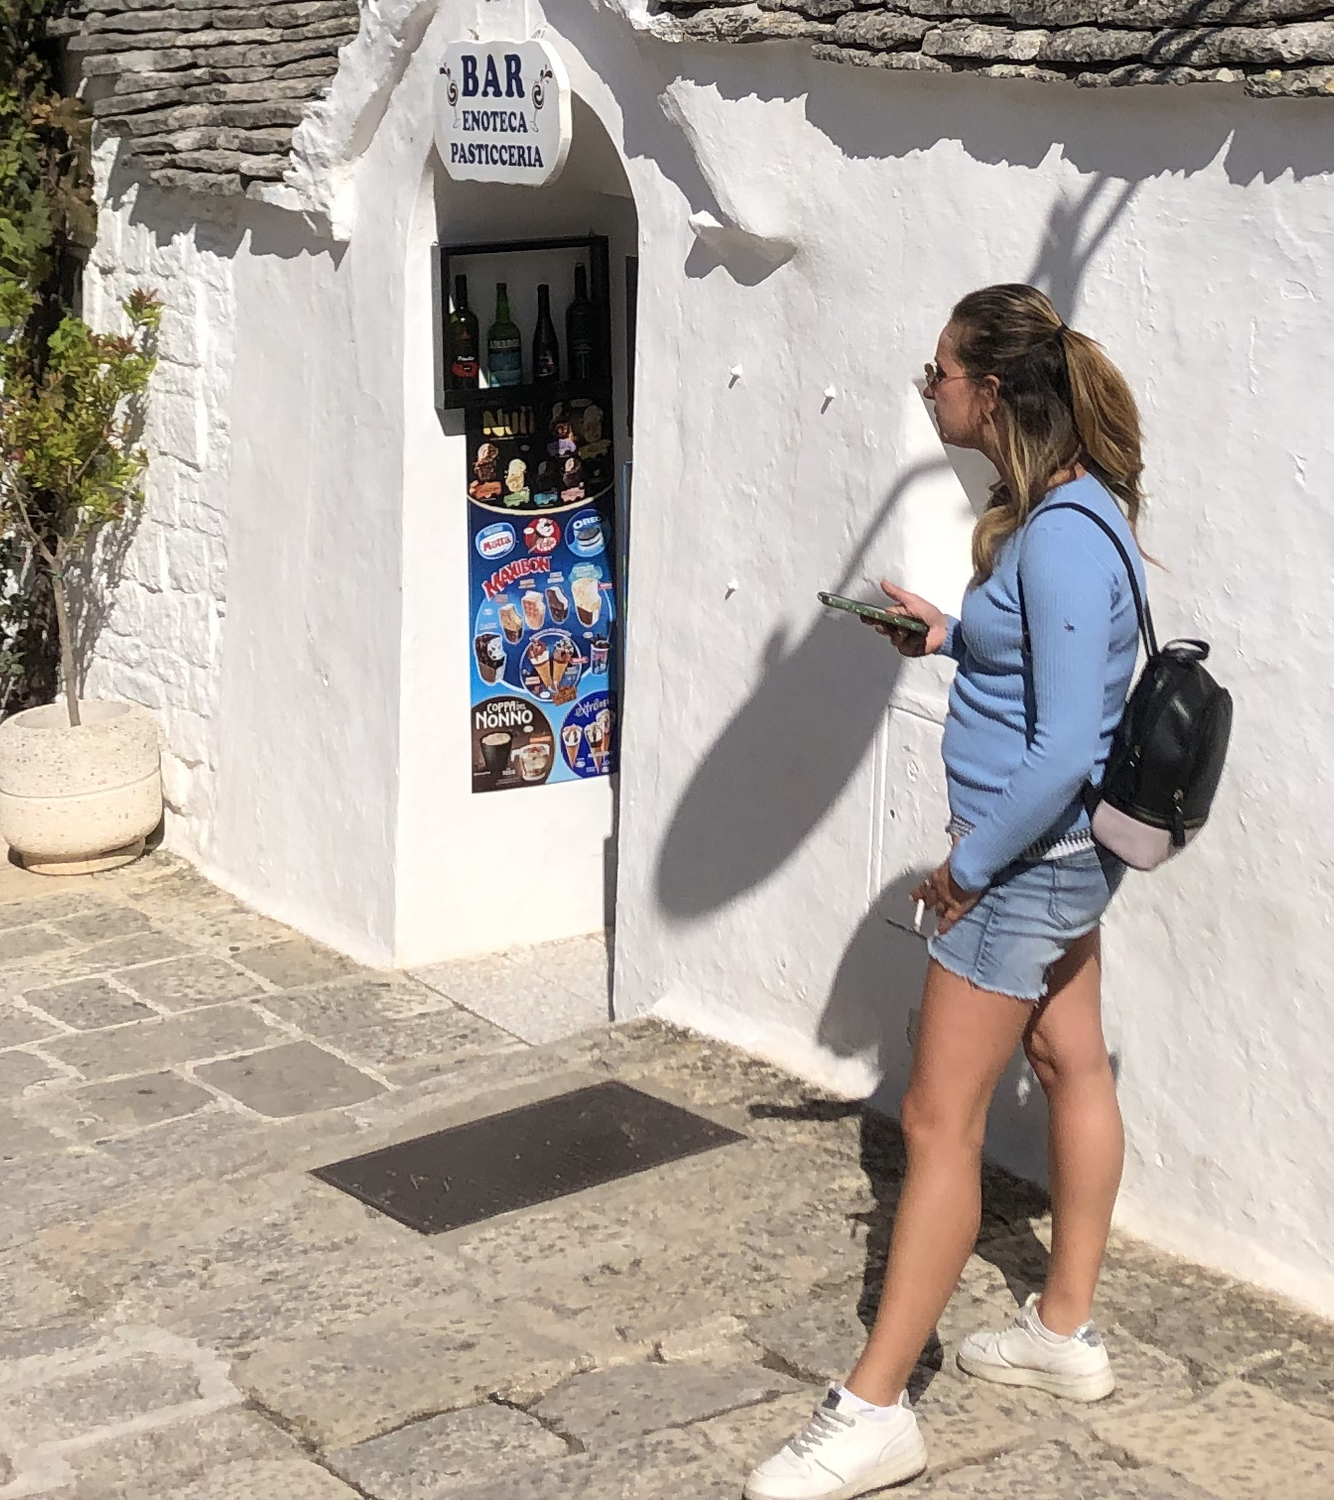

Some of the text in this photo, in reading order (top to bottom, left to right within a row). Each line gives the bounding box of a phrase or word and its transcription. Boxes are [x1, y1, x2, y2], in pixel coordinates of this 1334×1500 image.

[460, 53, 526, 98] BAR
[462, 109, 529, 133] ENOTECA
[450, 142, 544, 168] PASTICCERIA
[572, 515, 602, 529] OREO
[483, 536, 512, 552] Motta
[481, 555, 553, 602] MAXIBON
[475, 710, 534, 730] NONNO
